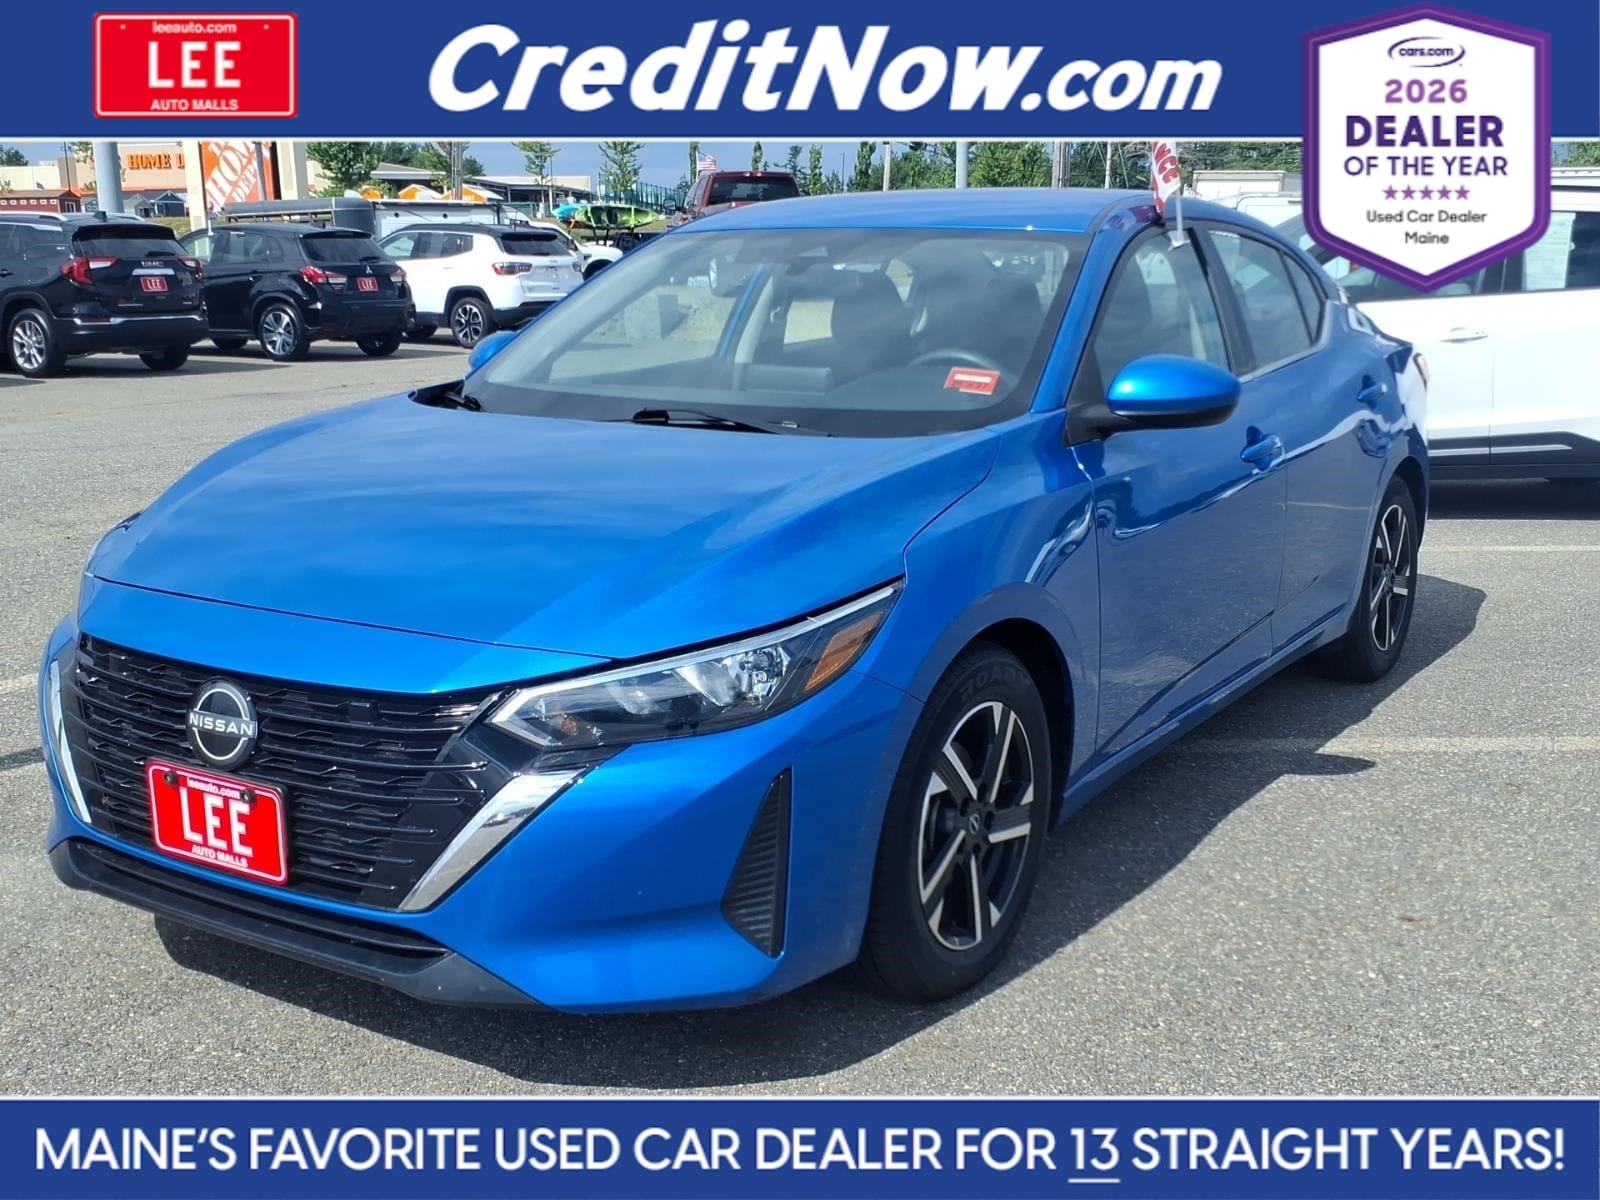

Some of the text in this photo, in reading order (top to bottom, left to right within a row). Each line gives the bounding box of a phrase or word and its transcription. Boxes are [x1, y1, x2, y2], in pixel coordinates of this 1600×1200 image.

[127, 153, 172, 170] HOME
[146, 279, 162, 289] LEE
[189, 711, 254, 736] NISSAN
[186, 776, 241, 800] leeauto.com
[179, 786, 253, 858] LEE
[191, 844, 249, 868] AUTO MALLS
